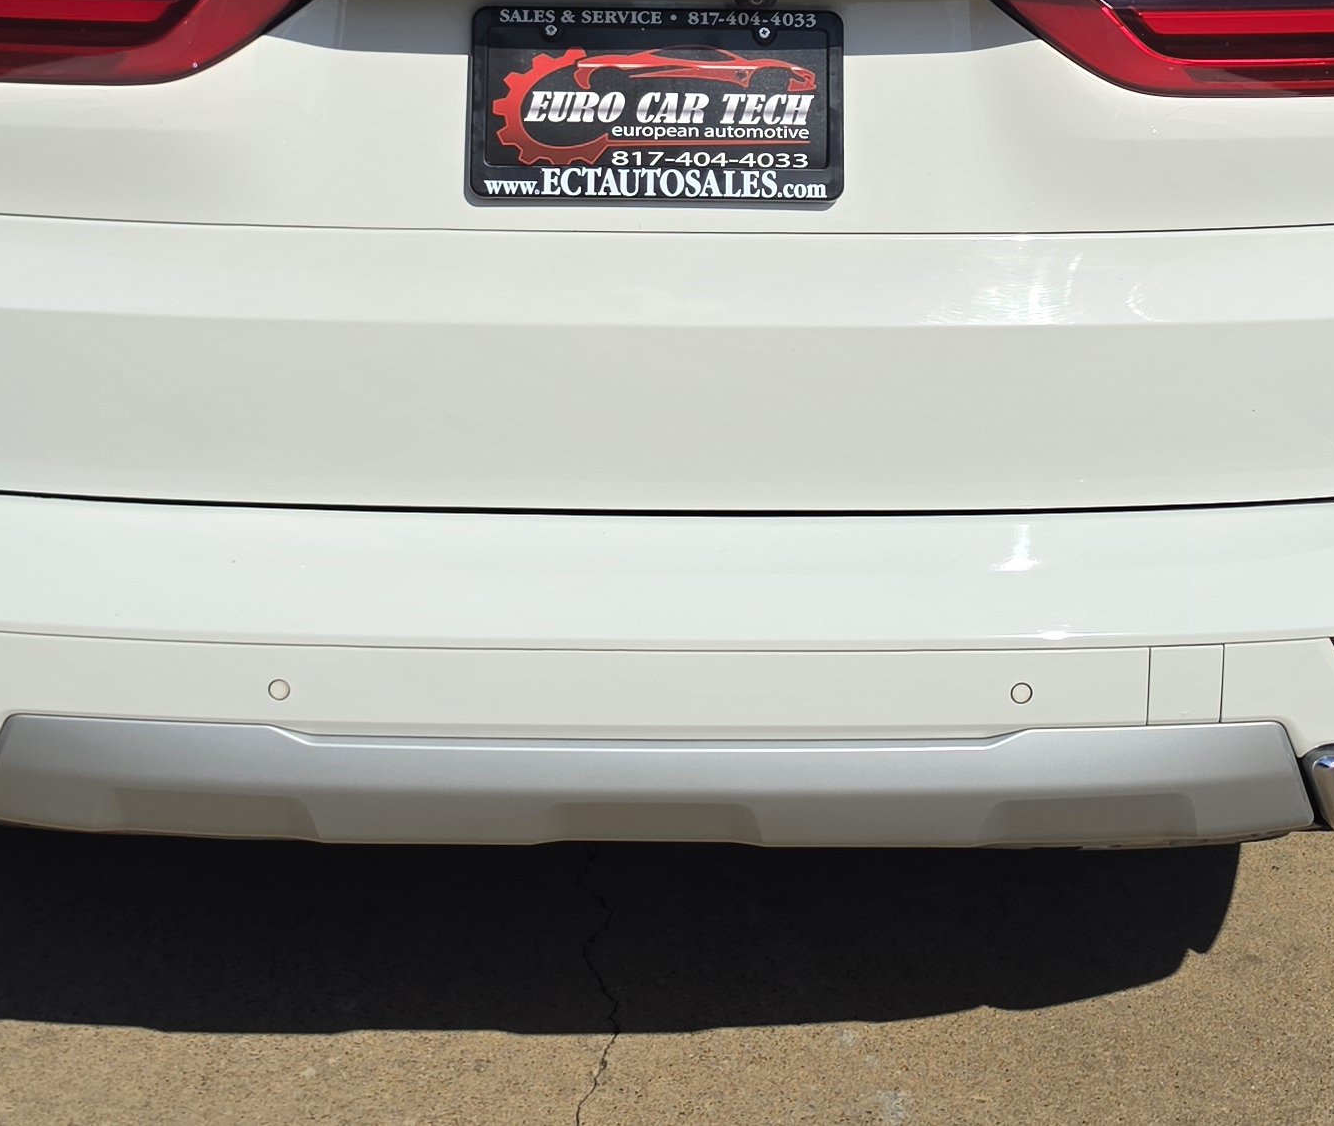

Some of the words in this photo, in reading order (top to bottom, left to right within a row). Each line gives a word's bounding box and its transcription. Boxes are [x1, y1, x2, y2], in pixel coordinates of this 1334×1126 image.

[499, 9, 556, 24] SALES
[560, 10, 576, 24] &
[581, 10, 663, 25] SERVICE
[687, 11, 818, 28] 817-404-4033
[523, 90, 627, 123] EURO
[635, 91, 710, 125] CAR
[720, 93, 814, 126] TECH
[611, 125, 701, 140] european
[703, 125, 810, 140] automotive
[611, 150, 810, 168] 817-404-4033
[483, 167, 828, 199] www.ECTAUTOSALES.com
